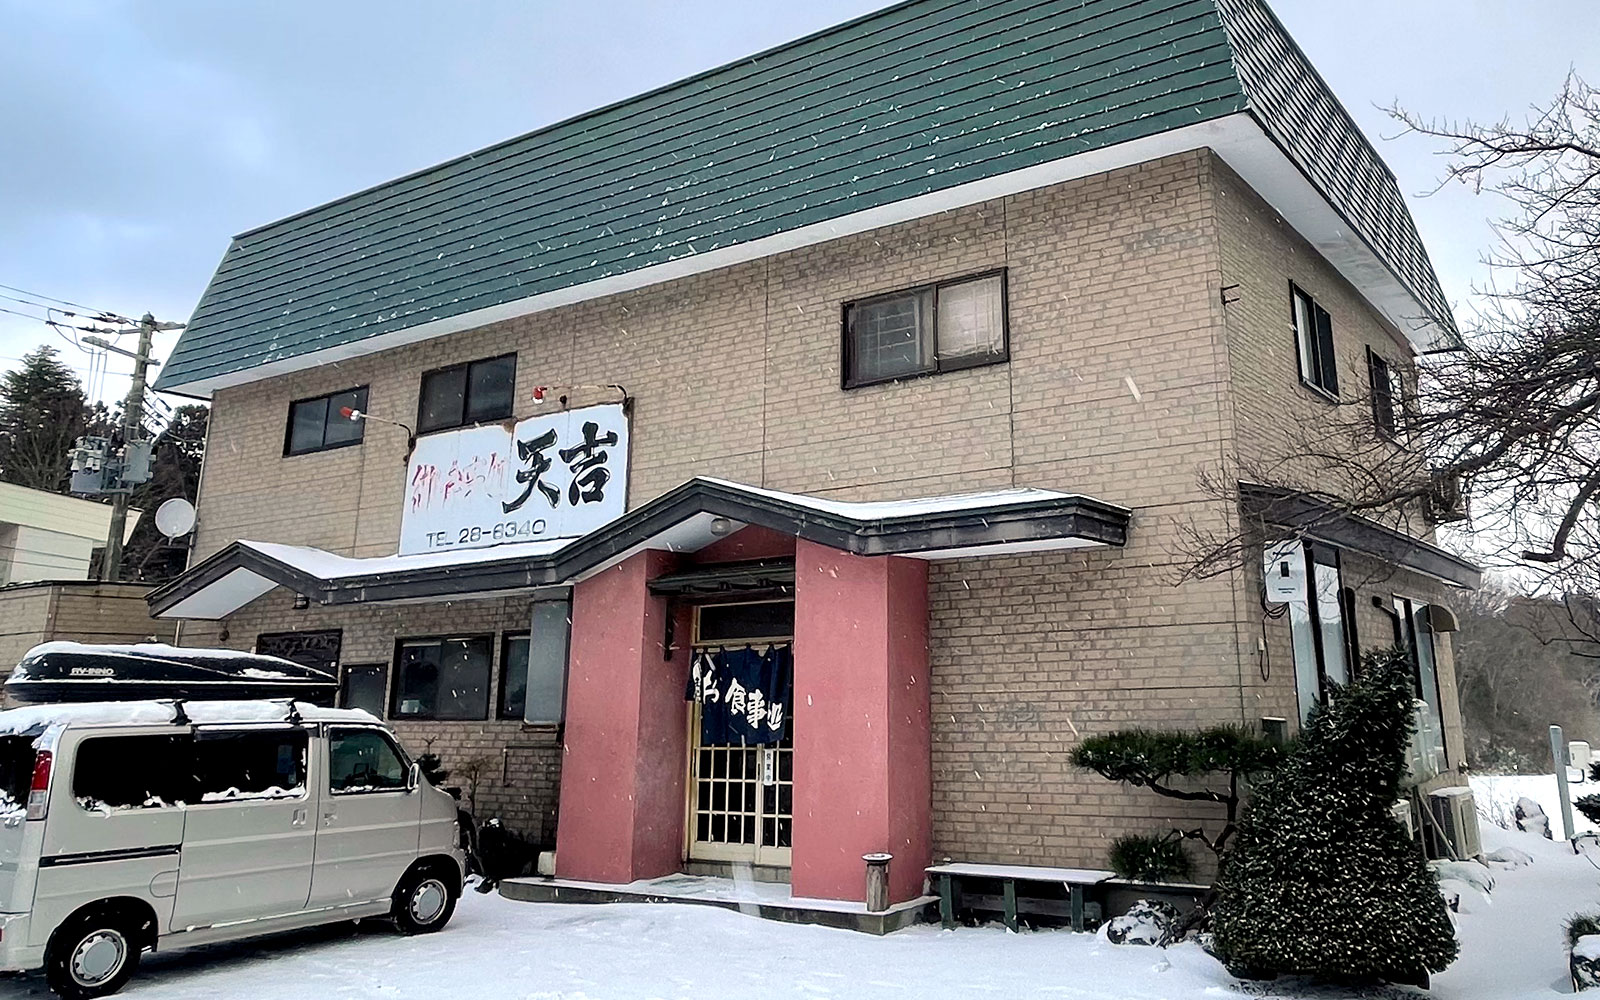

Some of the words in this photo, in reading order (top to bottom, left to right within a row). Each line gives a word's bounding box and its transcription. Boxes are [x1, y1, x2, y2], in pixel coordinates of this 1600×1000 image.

[502, 421, 618, 514] 天吉
[426, 531, 454, 548] TEL
[459, 519, 547, 544] 28-6340
